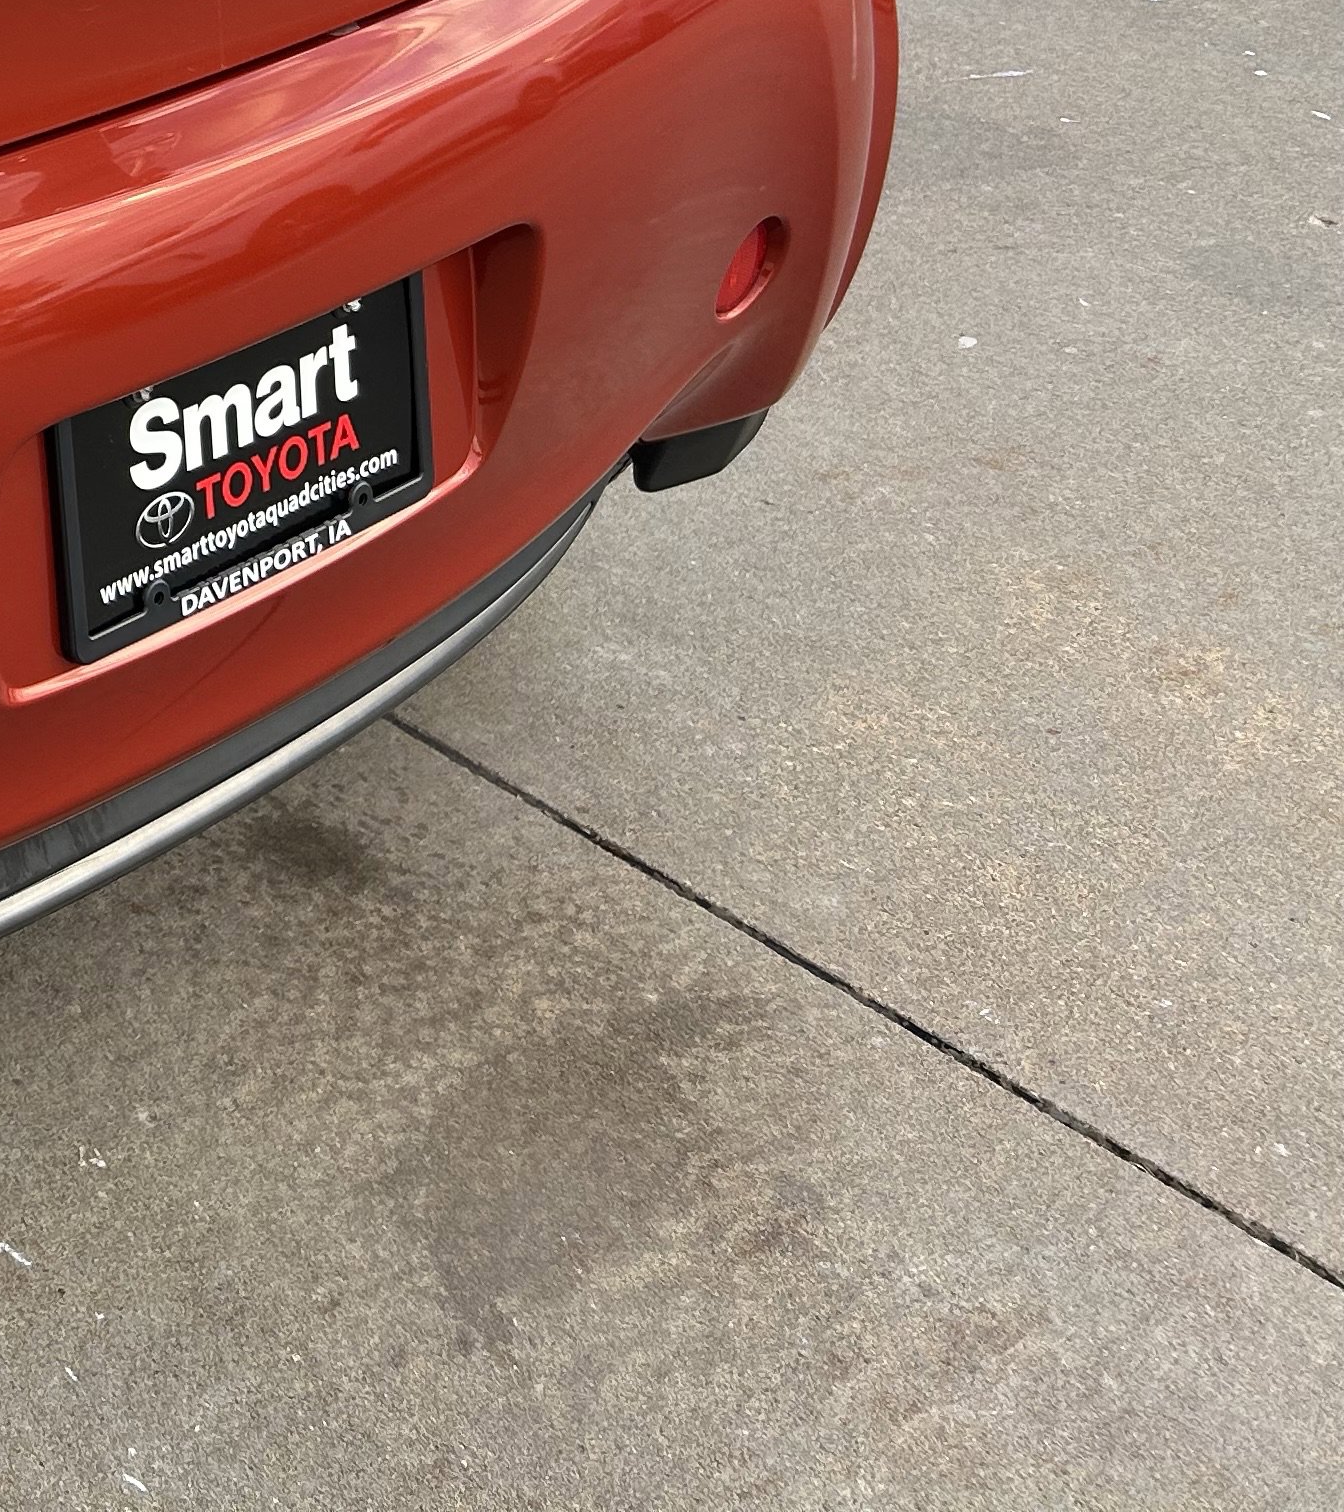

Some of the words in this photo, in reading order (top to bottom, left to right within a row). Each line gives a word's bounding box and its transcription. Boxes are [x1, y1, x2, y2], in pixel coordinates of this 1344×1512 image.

[128, 323, 359, 490] Smart
[195, 413, 360, 520] TOYOTA
[99, 448, 399, 606] www.smarttoyotaquadcities.com
[179, 530, 324, 618] DAVENPORT,
[326, 519, 352, 546] IA
